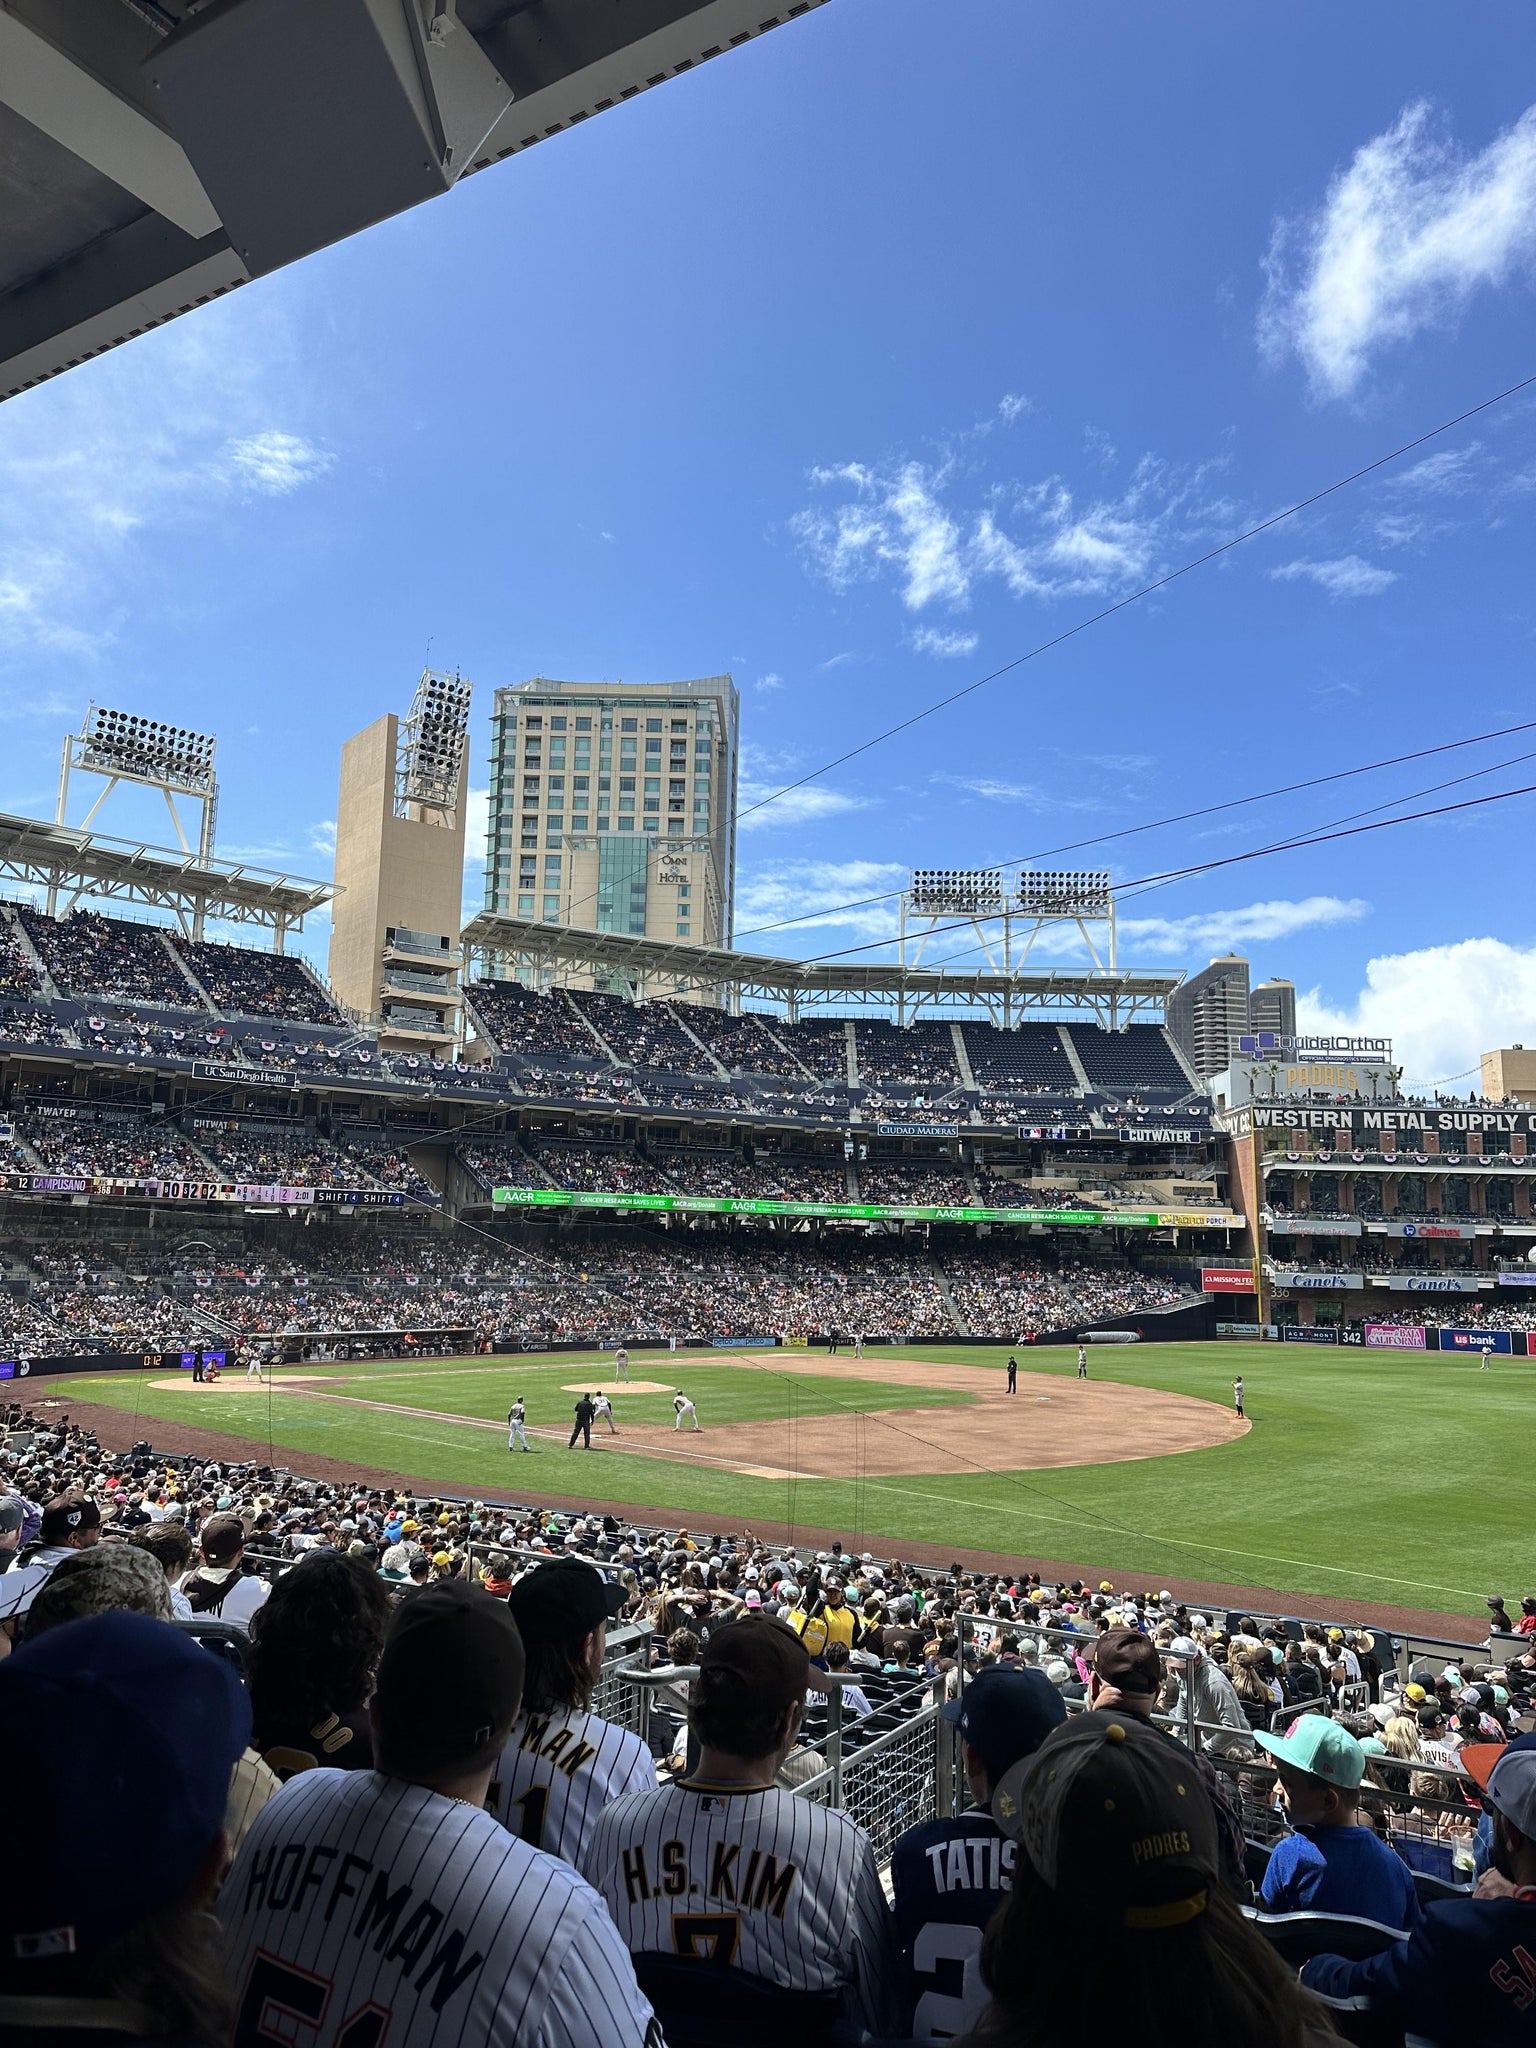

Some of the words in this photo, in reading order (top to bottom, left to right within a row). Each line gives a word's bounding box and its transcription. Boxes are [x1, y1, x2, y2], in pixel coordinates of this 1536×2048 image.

[1279, 1036, 1385, 1052] QuidelOrtho
[204, 1066, 219, 1076] UC
[219, 1068, 236, 1079] San
[236, 1070, 260, 1083] Diego
[260, 1072, 287, 1084] Health
[1287, 1064, 1358, 1092] PADRES
[193, 1119, 239, 1131] CUTWATR
[1253, 1109, 1353, 1128] WESTERN
[1363, 1112, 1433, 1130] METAL
[1438, 1113, 1520, 1132] SUPPLY
[1129, 1131, 1191, 1142] CUTWATER
[18, 1178, 28, 1188] 12
[32, 1177, 86, 1191] CAMPUSANO
[190, 1184, 198, 1199] 2
[209, 1185, 217, 1199] 2
[318, 1192, 348, 1201] SHIFT
[364, 1194, 393, 1203] SHIFT
[503, 1192, 534, 1202] AACR
[731, 1202, 756, 1211] AACR
[936, 1210, 963, 1218] AACR
[1292, 1275, 1347, 1288] Canel's
[1407, 1278, 1462, 1291] Canel's
[1270, 1287, 1290, 1298] 336
[1342, 1332, 1361, 1343] 342
[1400, 1330, 1420, 1338] BAJA
[1368, 1335, 1424, 1346] CALIFORNIA
[1455, 1336, 1467, 1344] us
[1469, 1336, 1496, 1346] bank
[1131, 1831, 1191, 1864] PADRES
[622, 1840, 698, 1904] H.S.
[710, 1840, 796, 1918] KIM
[243, 1843, 483, 2013] HOFFMAN
